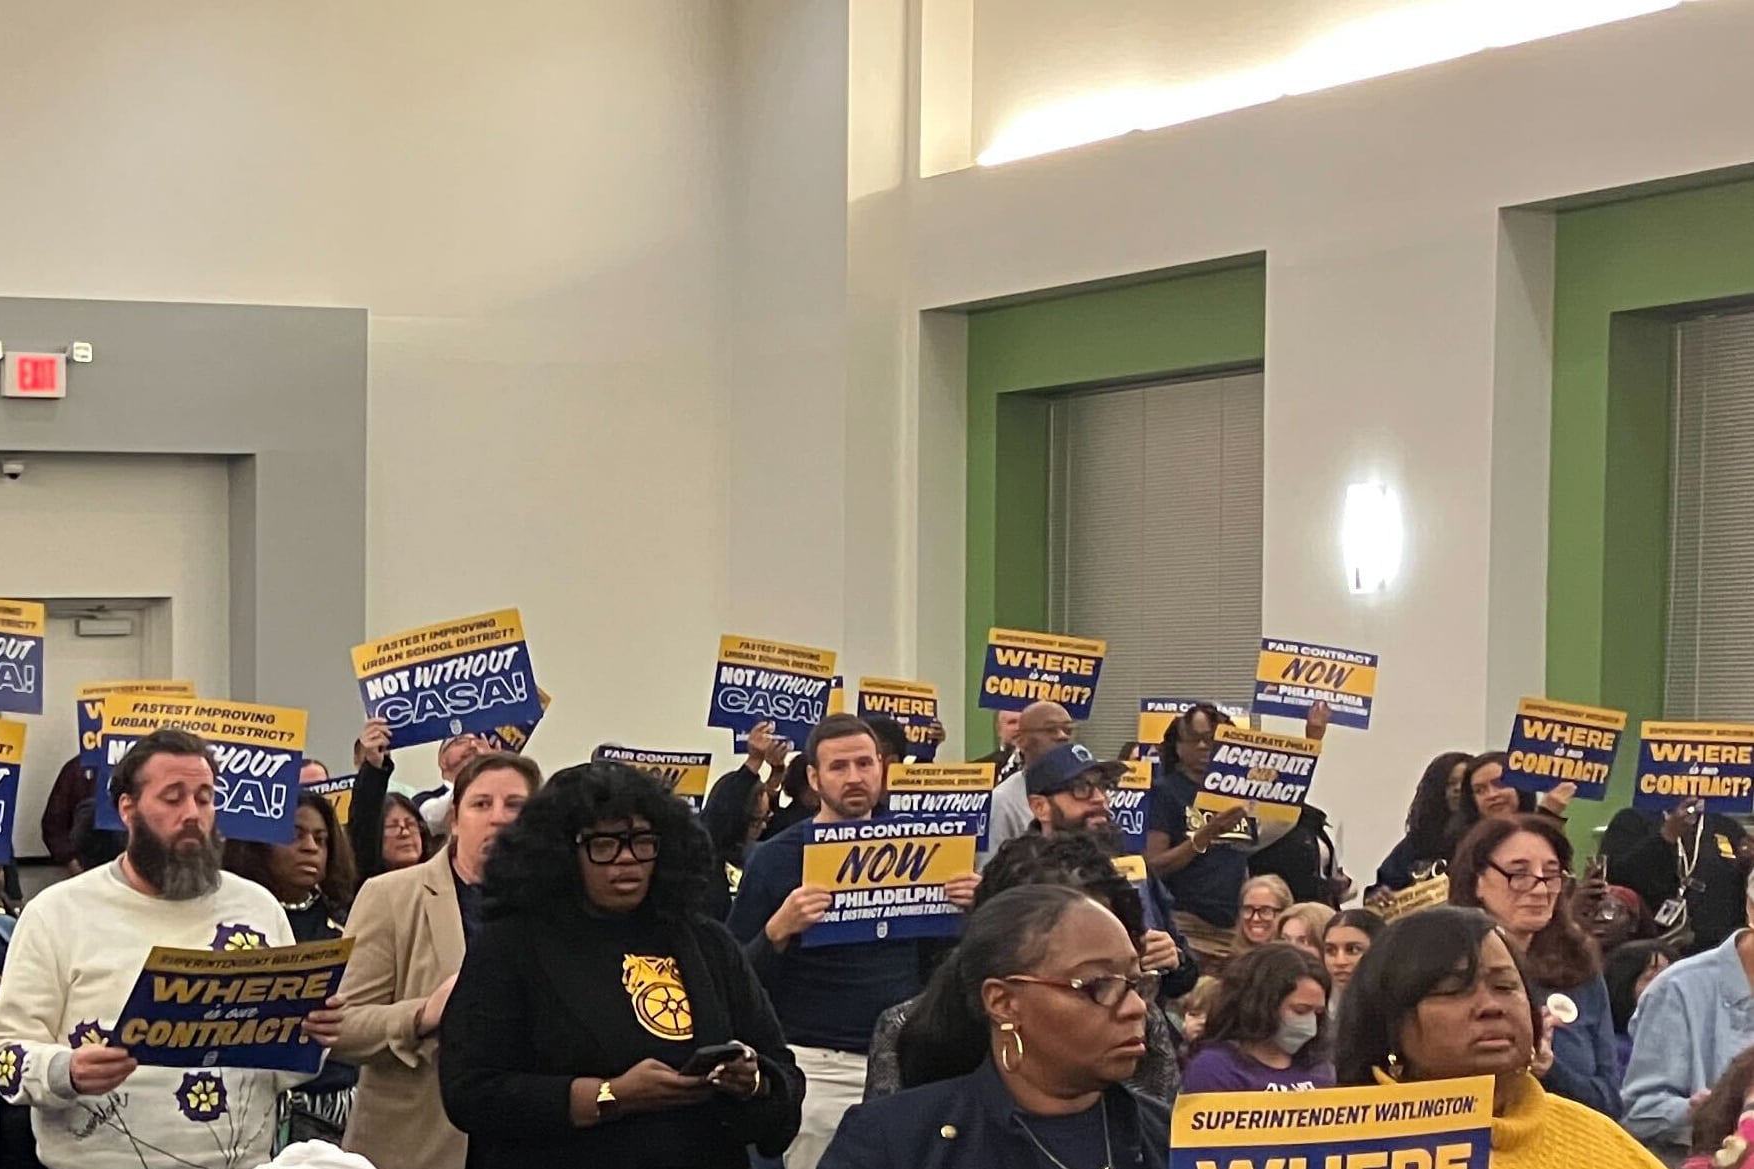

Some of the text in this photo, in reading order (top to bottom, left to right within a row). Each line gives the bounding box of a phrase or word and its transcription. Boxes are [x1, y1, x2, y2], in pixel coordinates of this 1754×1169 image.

[18, 358, 57, 392] EXIT
[376, 618, 496, 654] FASTEST IMPROVING
[362, 628, 514, 672] URBAN SCHOOL DISTRICT?
[996, 648, 1095, 675] WHERE
[1268, 642, 1372, 665] FAIR CONTRACT
[366, 646, 519, 701] NOT WITHOUT
[720, 666, 827, 697] NOT WITHOUT
[1281, 657, 1355, 689] NOW
[375, 671, 527, 729] CASA!
[985, 676, 1091, 704] CONTRACT?
[1279, 684, 1363, 707] PHILADELPHIA
[132, 702, 276, 724] FASTEST IMPROVING
[718, 686, 823, 725] CASA!
[864, 694, 935, 717] WHERE
[1147, 702, 1177, 712] FAIR
[111, 716, 157, 729] URBAN
[222, 723, 295, 743] DISTRICT?
[1222, 730, 1283, 747] ACCELERATE
[1523, 719, 1616, 751] WHERE
[604, 749, 706, 764] FAIR CONTRACT
[1213, 745, 1314, 775] ACCELERATE
[1508, 750, 1609, 784] CONTRACT?
[1650, 743, 1753, 764] WHERE
[1204, 771, 1306, 803] CONTRACT
[1640, 773, 1752, 797] CONTRACT?
[889, 793, 989, 812] NOT WITHOUT
[814, 821, 966, 842] FAIR CONTRACT
[835, 842, 941, 884] NOW
[835, 887, 948, 909] PHILADELPHI
[842, 908, 882, 921] DISTRICT
[153, 971, 333, 1004] WHERE
[1191, 1104, 1371, 1131] SUPERINTENDENT
